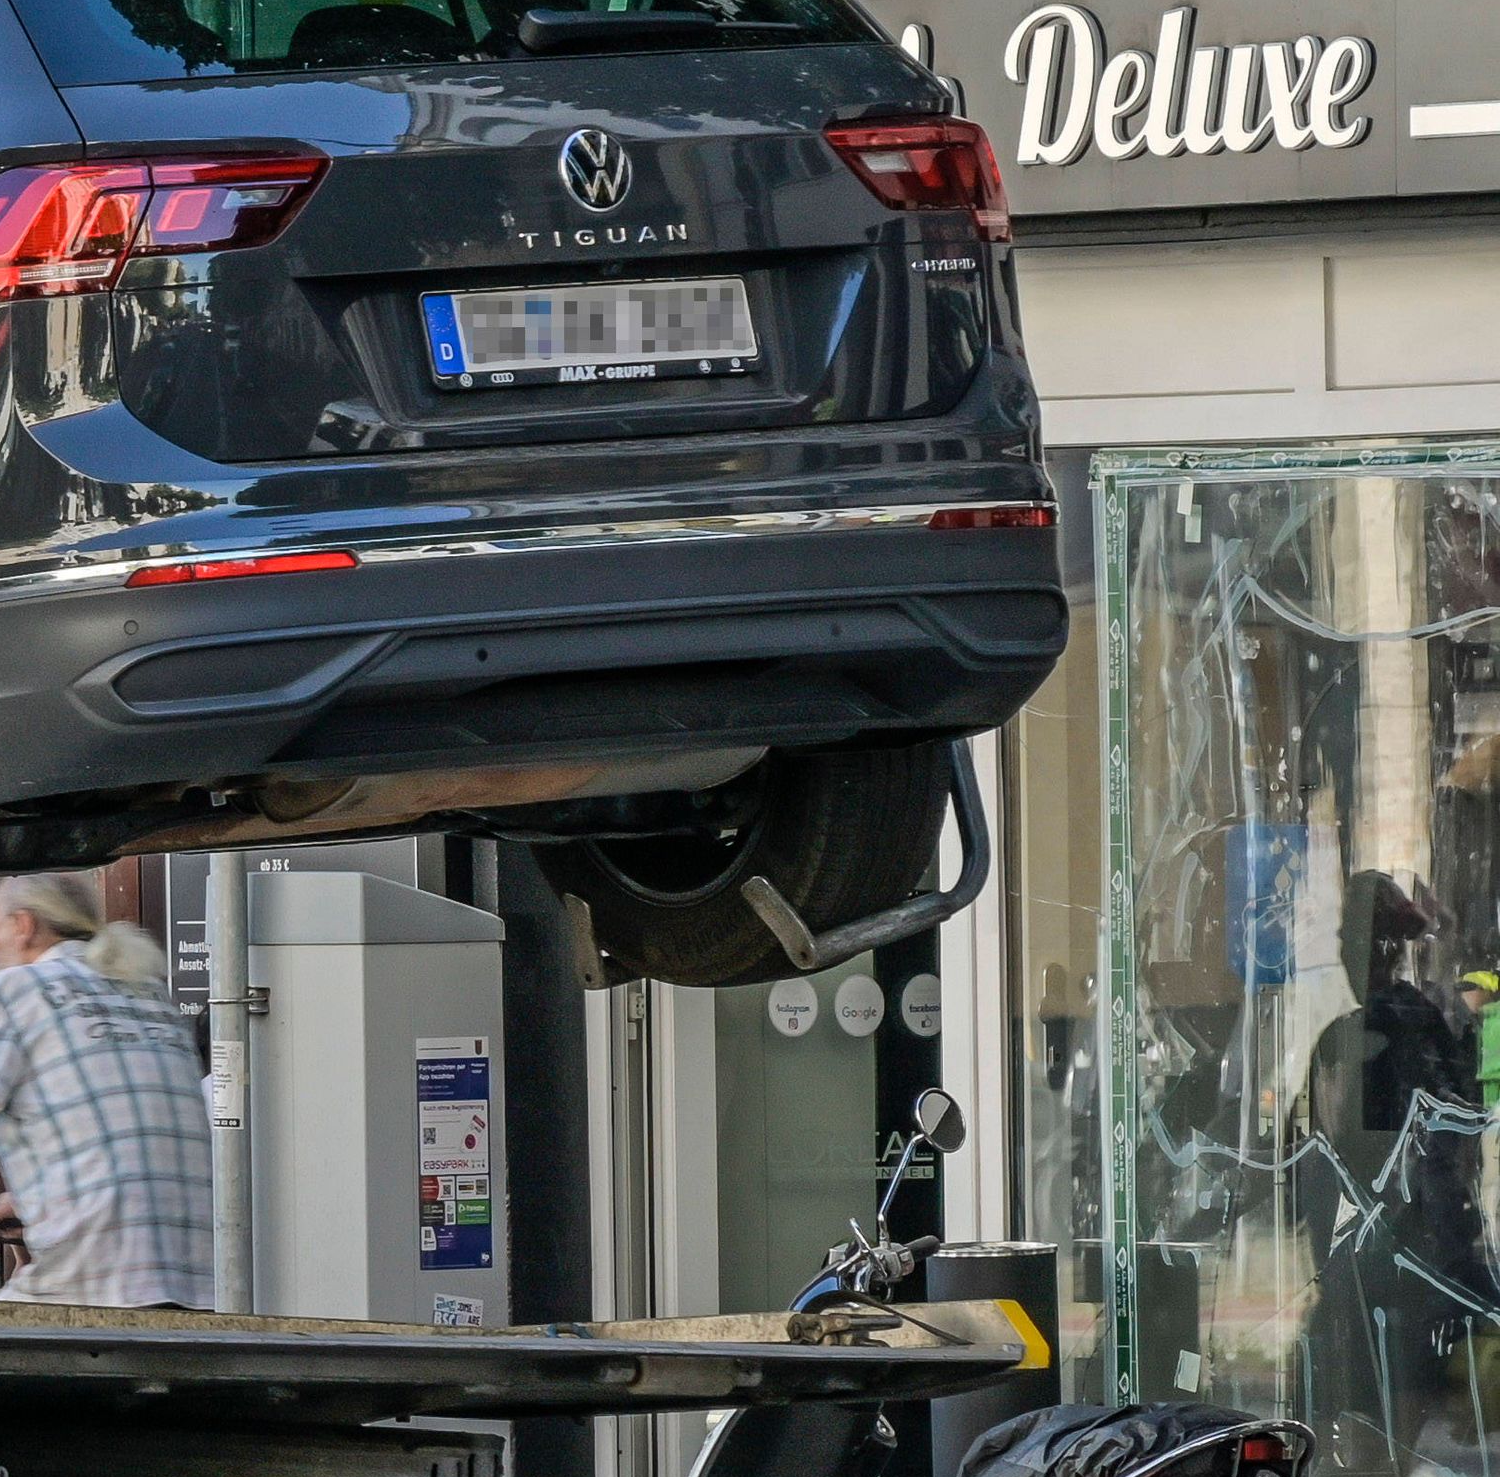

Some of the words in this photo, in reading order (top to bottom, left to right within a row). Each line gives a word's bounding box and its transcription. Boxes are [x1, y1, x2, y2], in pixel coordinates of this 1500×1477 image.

[1003, 5, 1376, 167] Deluxe
[518, 223, 688, 249] TIGUAN
[440, 344, 453, 362] D
[260, 859, 270, 872] ab
[842, 1006, 878, 1021] Google
